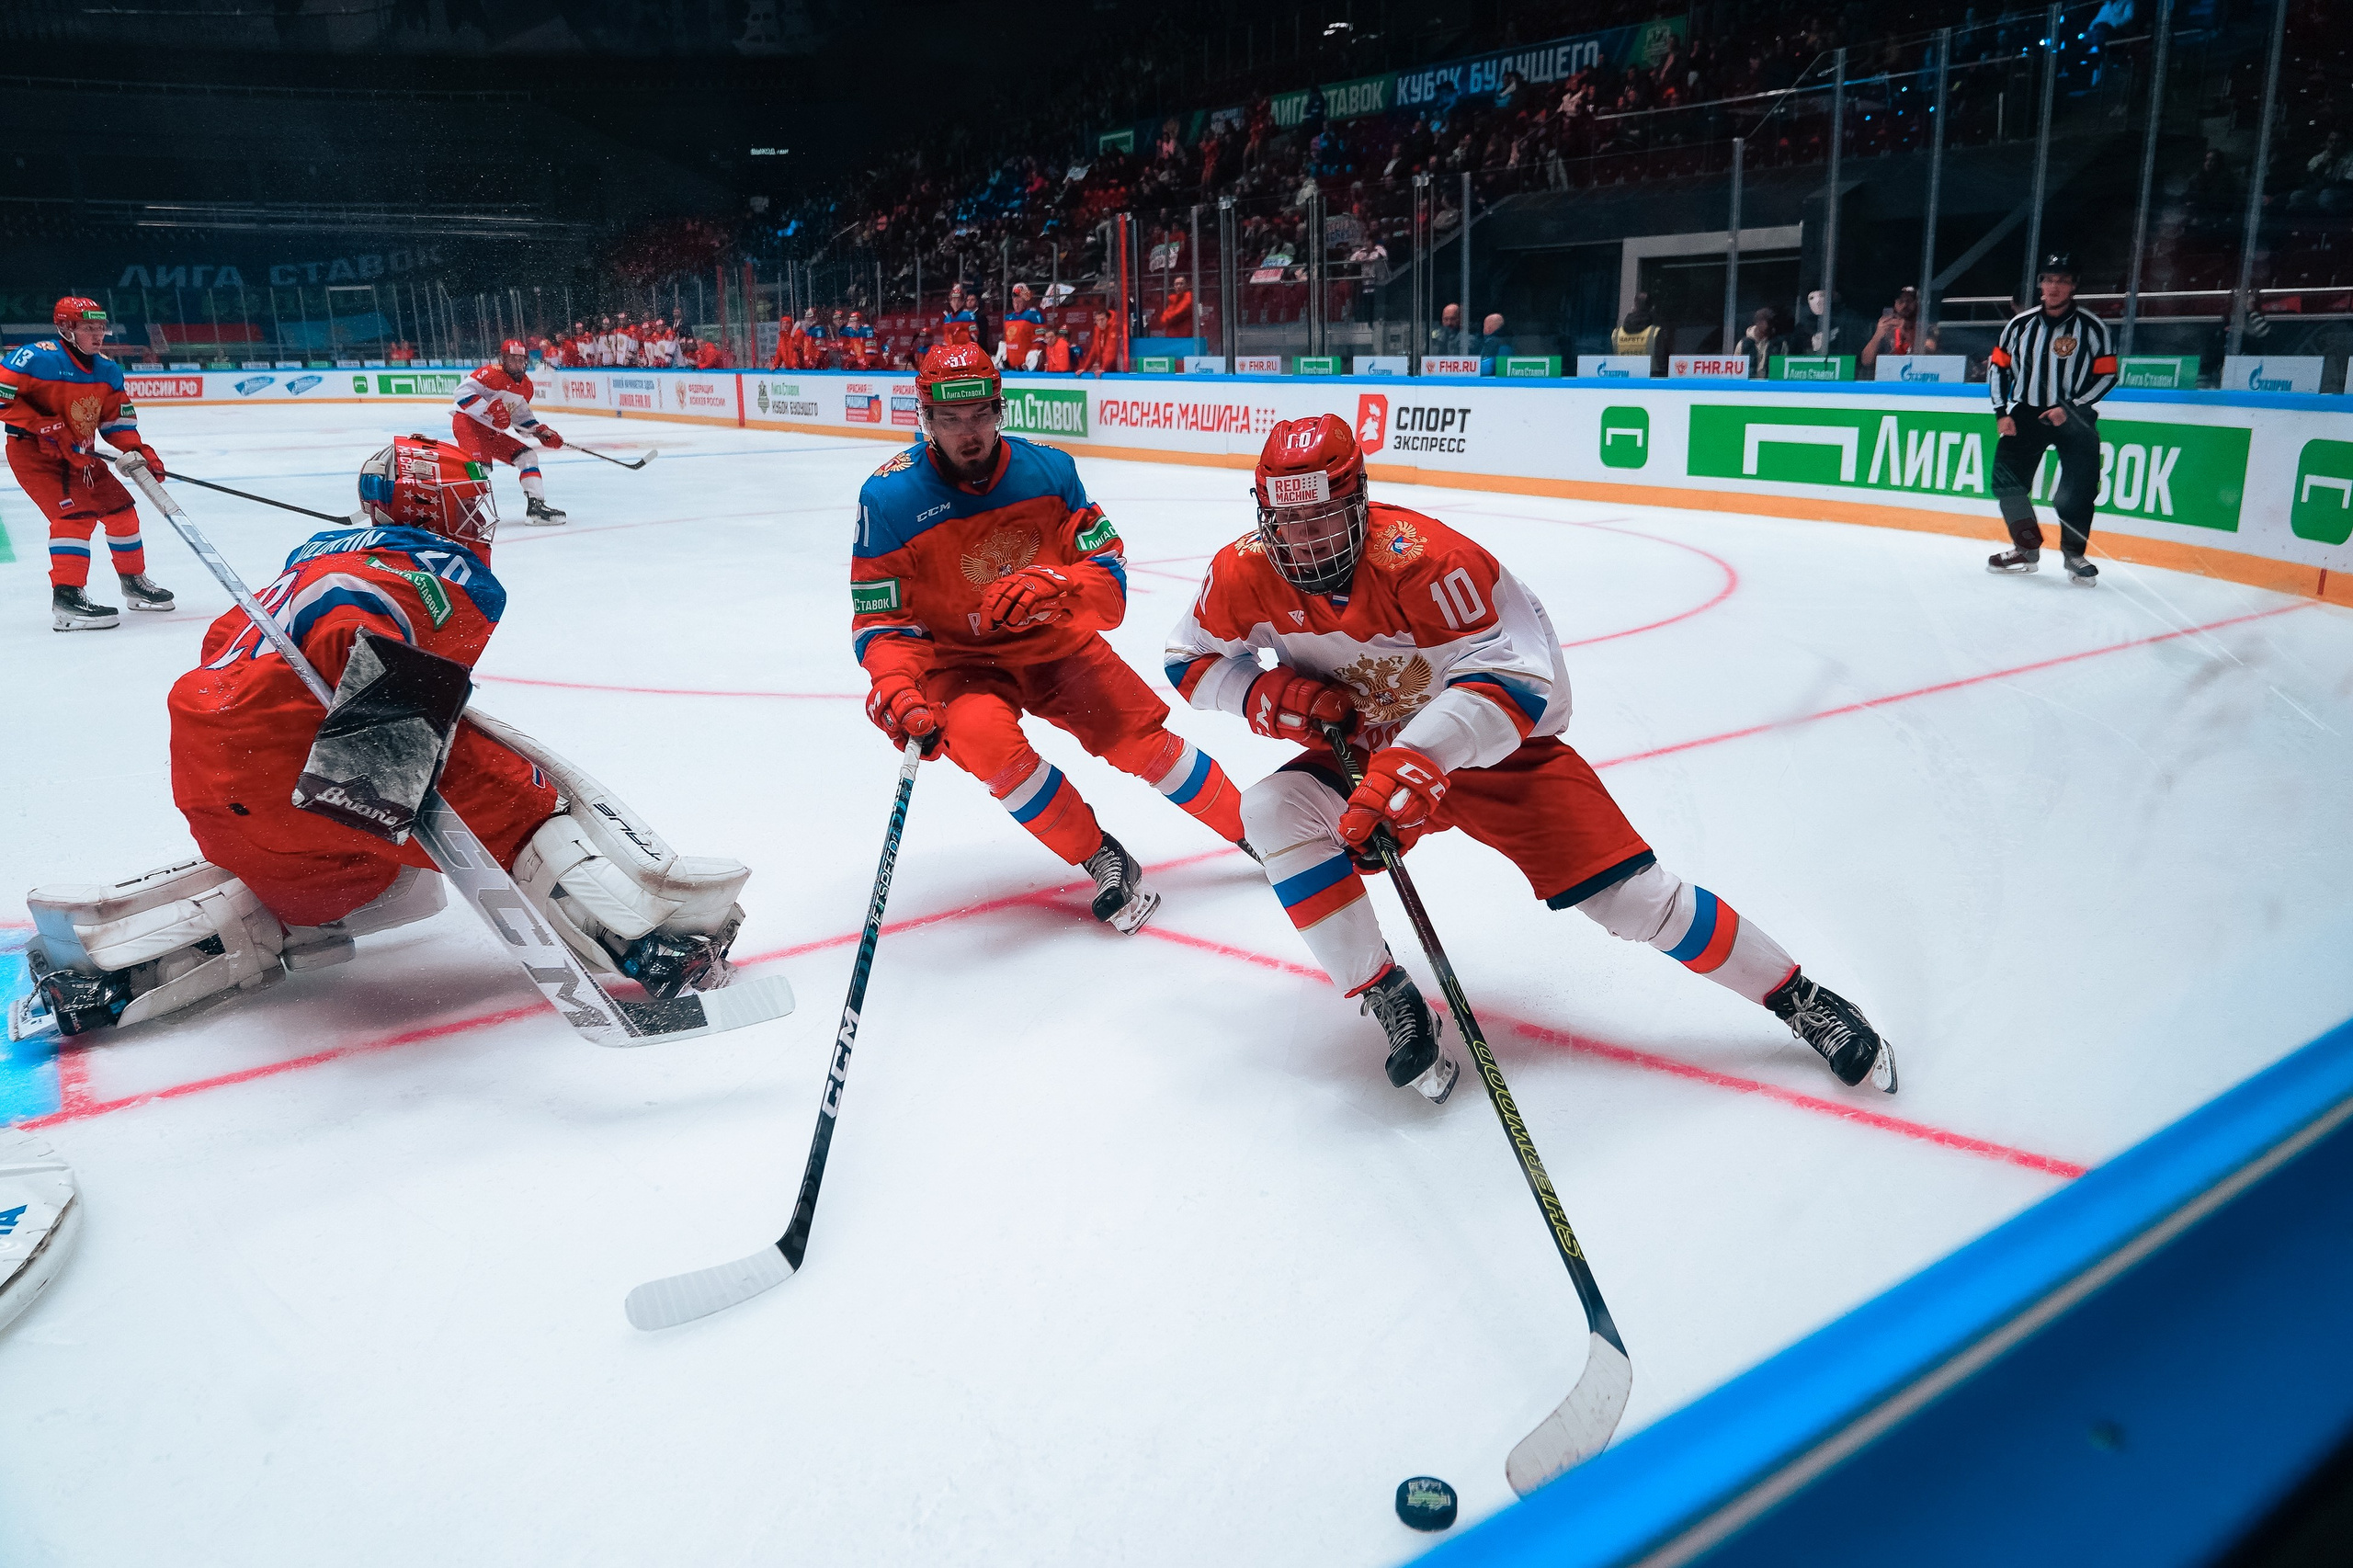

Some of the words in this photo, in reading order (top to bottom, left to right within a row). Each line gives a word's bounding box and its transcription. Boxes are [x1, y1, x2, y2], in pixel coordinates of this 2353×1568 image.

[1321, 81, 1384, 118] ТАВОК
[119, 265, 244, 289] ЛИГА
[10, 347, 34, 368] 13
[1249, 360, 1277, 371] FHR.RU
[1438, 360, 1477, 372] FHR.RU
[1693, 360, 1744, 375] FHR.RU
[947, 391, 961, 399] ЛИГА
[961, 390, 983, 398] СТАВОК
[1025, 393, 1084, 432] СТАВОК
[1099, 399, 1174, 427] КРАСНАЯ
[1176, 403, 1251, 434] МАШИНА
[1395, 406, 1471, 434] СПОРТ
[1393, 436, 1466, 454] ЭКСПРЕСС
[1867, 415, 1984, 494] ЛИГА
[1275, 479, 1301, 493] RED
[1276, 488, 1319, 503] MACHINE
[916, 501, 951, 522] CCM
[1088, 530, 1111, 550] ЛИГА
[854, 597, 891, 611] СТАВОК
[1429, 566, 1488, 631] 10
[592, 801, 663, 861] TRUE
[869, 838, 900, 936] JETSPEED
[422, 811, 611, 1027] CCM
[820, 1006, 860, 1119] CCM
[1471, 1039, 1586, 1261] SHERWOOD
